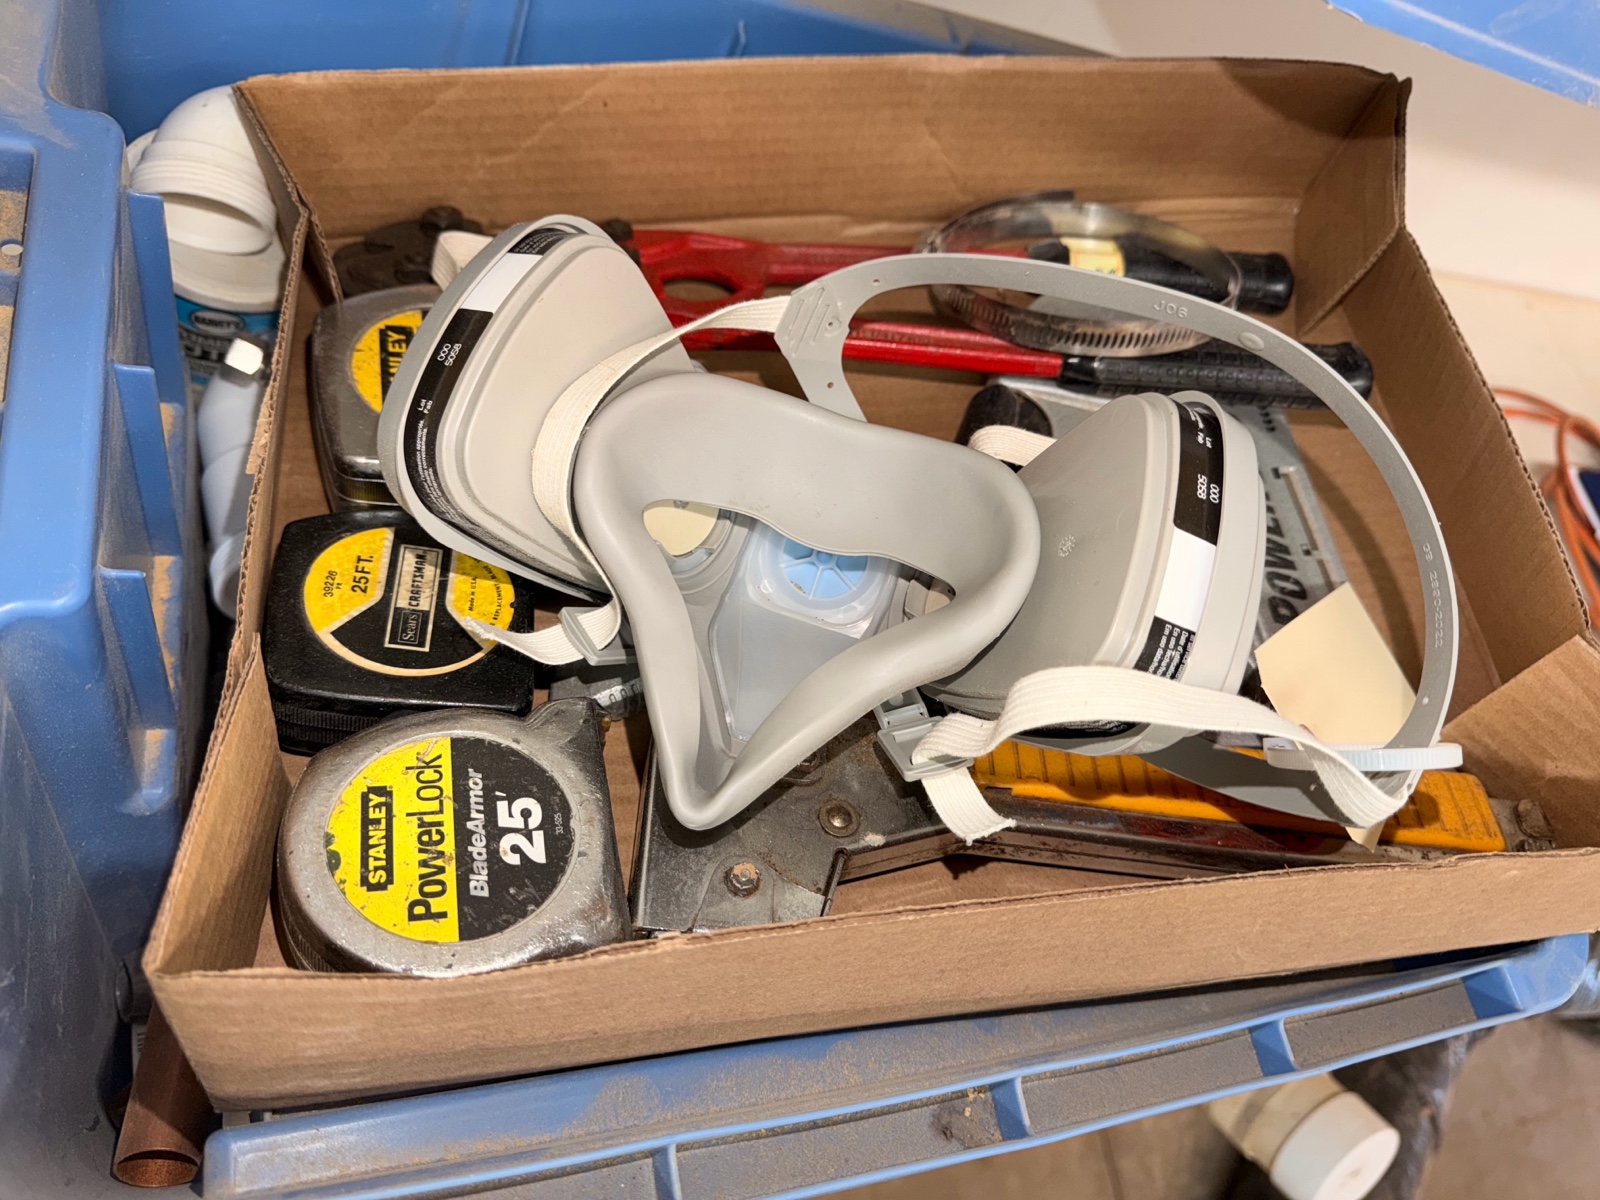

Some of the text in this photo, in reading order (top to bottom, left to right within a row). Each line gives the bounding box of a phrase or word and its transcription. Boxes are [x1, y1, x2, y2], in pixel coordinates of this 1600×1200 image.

[437, 344, 452, 361] 000
[424, 343, 462, 413] Fab 5058
[1197, 474, 1208, 499] 5058
[1210, 484, 1220, 503] 000
[323, 569, 338, 598] 39226
[483, 565, 497, 580] BLADE
[492, 583, 503, 620] REPLACEMENT
[402, 613, 418, 641] Sears
[1164, 624, 1172, 635] Em
[1172, 627, 1180, 637] En
[368, 792, 387, 884] STANLEY
[406, 753, 448, 923] PowerLock
[467, 768, 490, 898] BladeArmor
